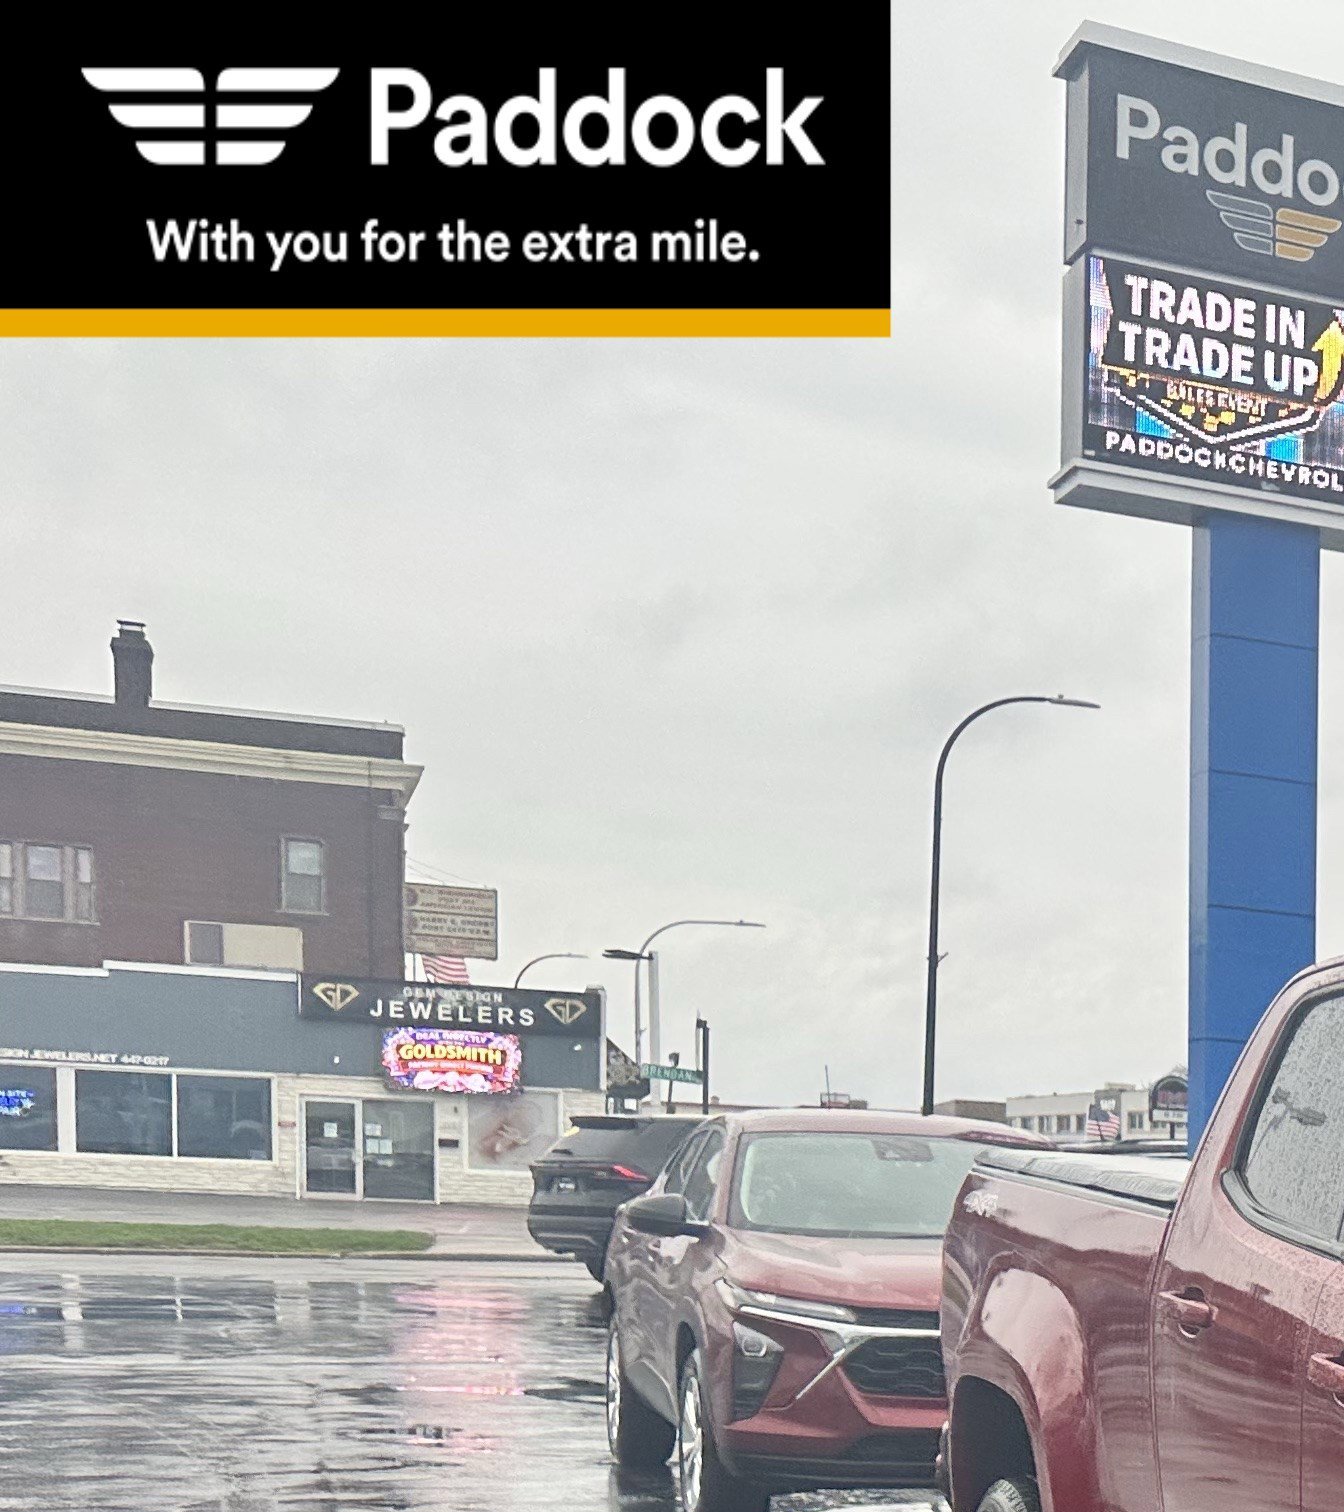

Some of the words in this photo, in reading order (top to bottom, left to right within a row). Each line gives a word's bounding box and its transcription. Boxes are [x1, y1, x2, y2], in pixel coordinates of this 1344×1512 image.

[1124, 274, 1256, 339] TRADE
[1266, 304, 1305, 350] IN
[1118, 321, 1255, 385] TRADE
[1263, 352, 1318, 397] UP
[403, 986, 435, 998] GEM
[370, 998, 535, 1026] JEWELERS
[400, 1043, 502, 1065] GOLDSMITH
